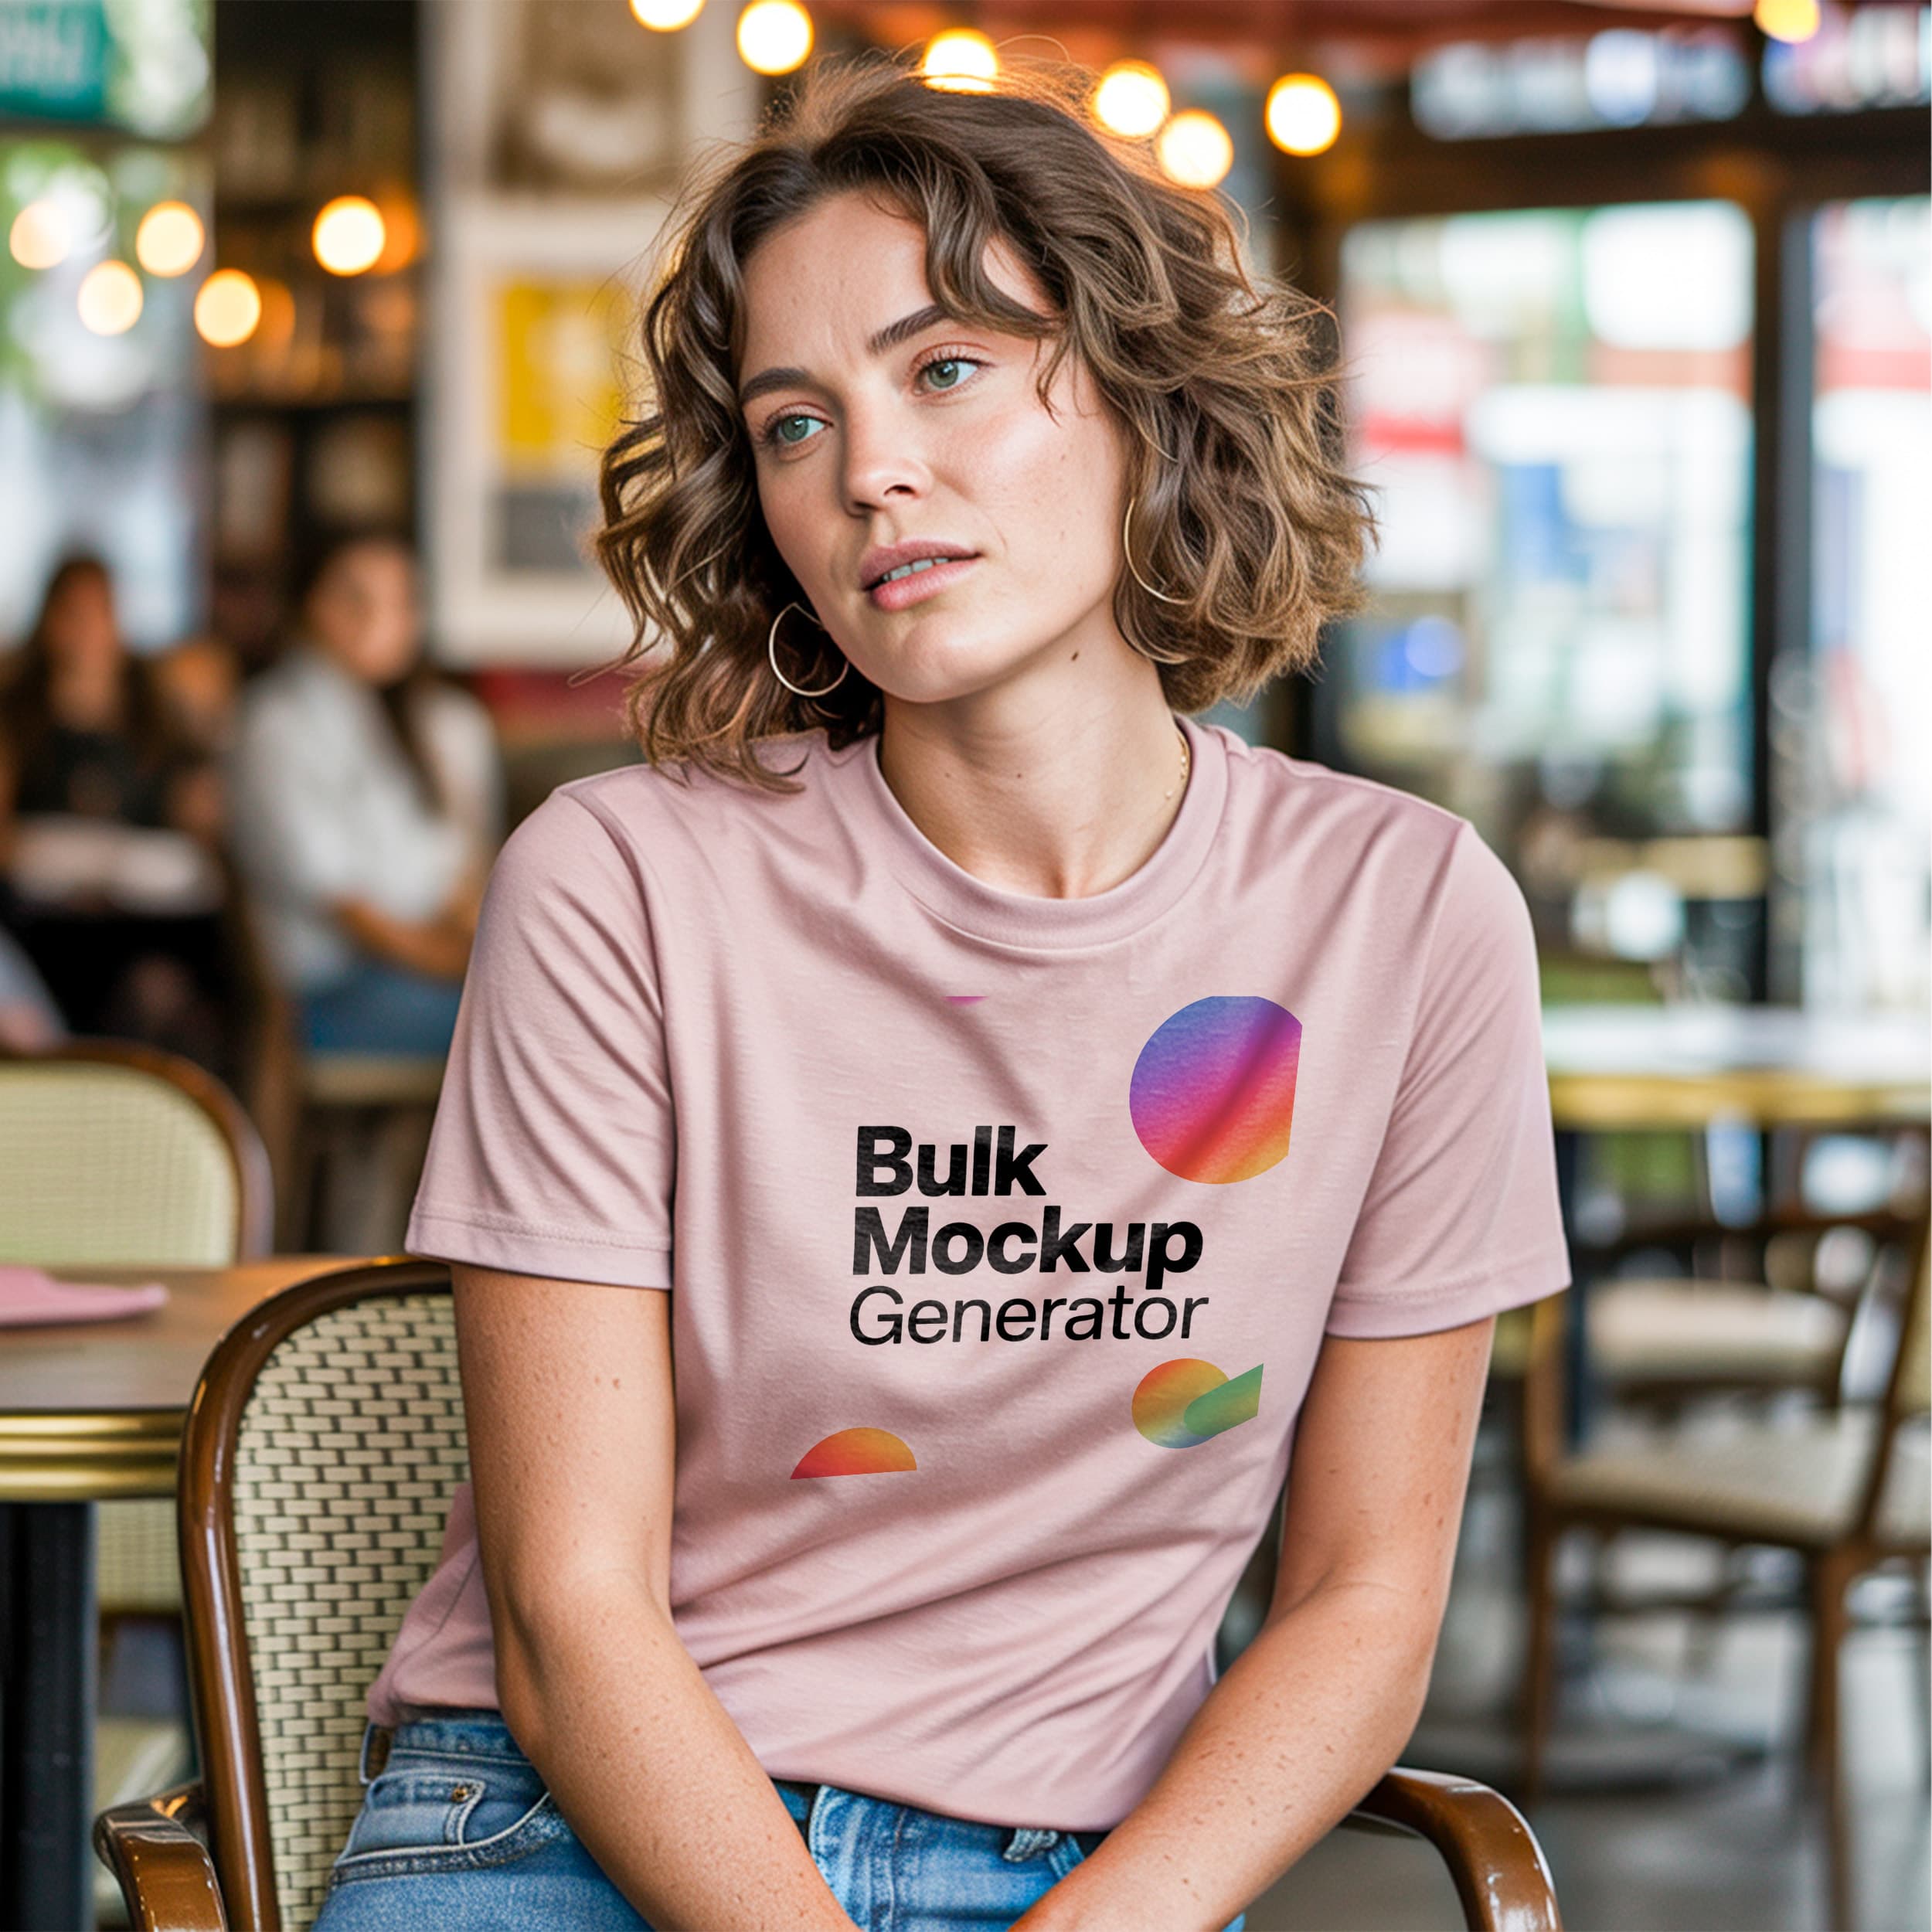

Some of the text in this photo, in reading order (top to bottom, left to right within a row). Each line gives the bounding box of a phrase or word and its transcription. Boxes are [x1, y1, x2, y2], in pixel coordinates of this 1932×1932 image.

[855, 1125, 1049, 1197] Bulk
[852, 1206, 1204, 1291] Mockup
[849, 1284, 1209, 1345] Generator
